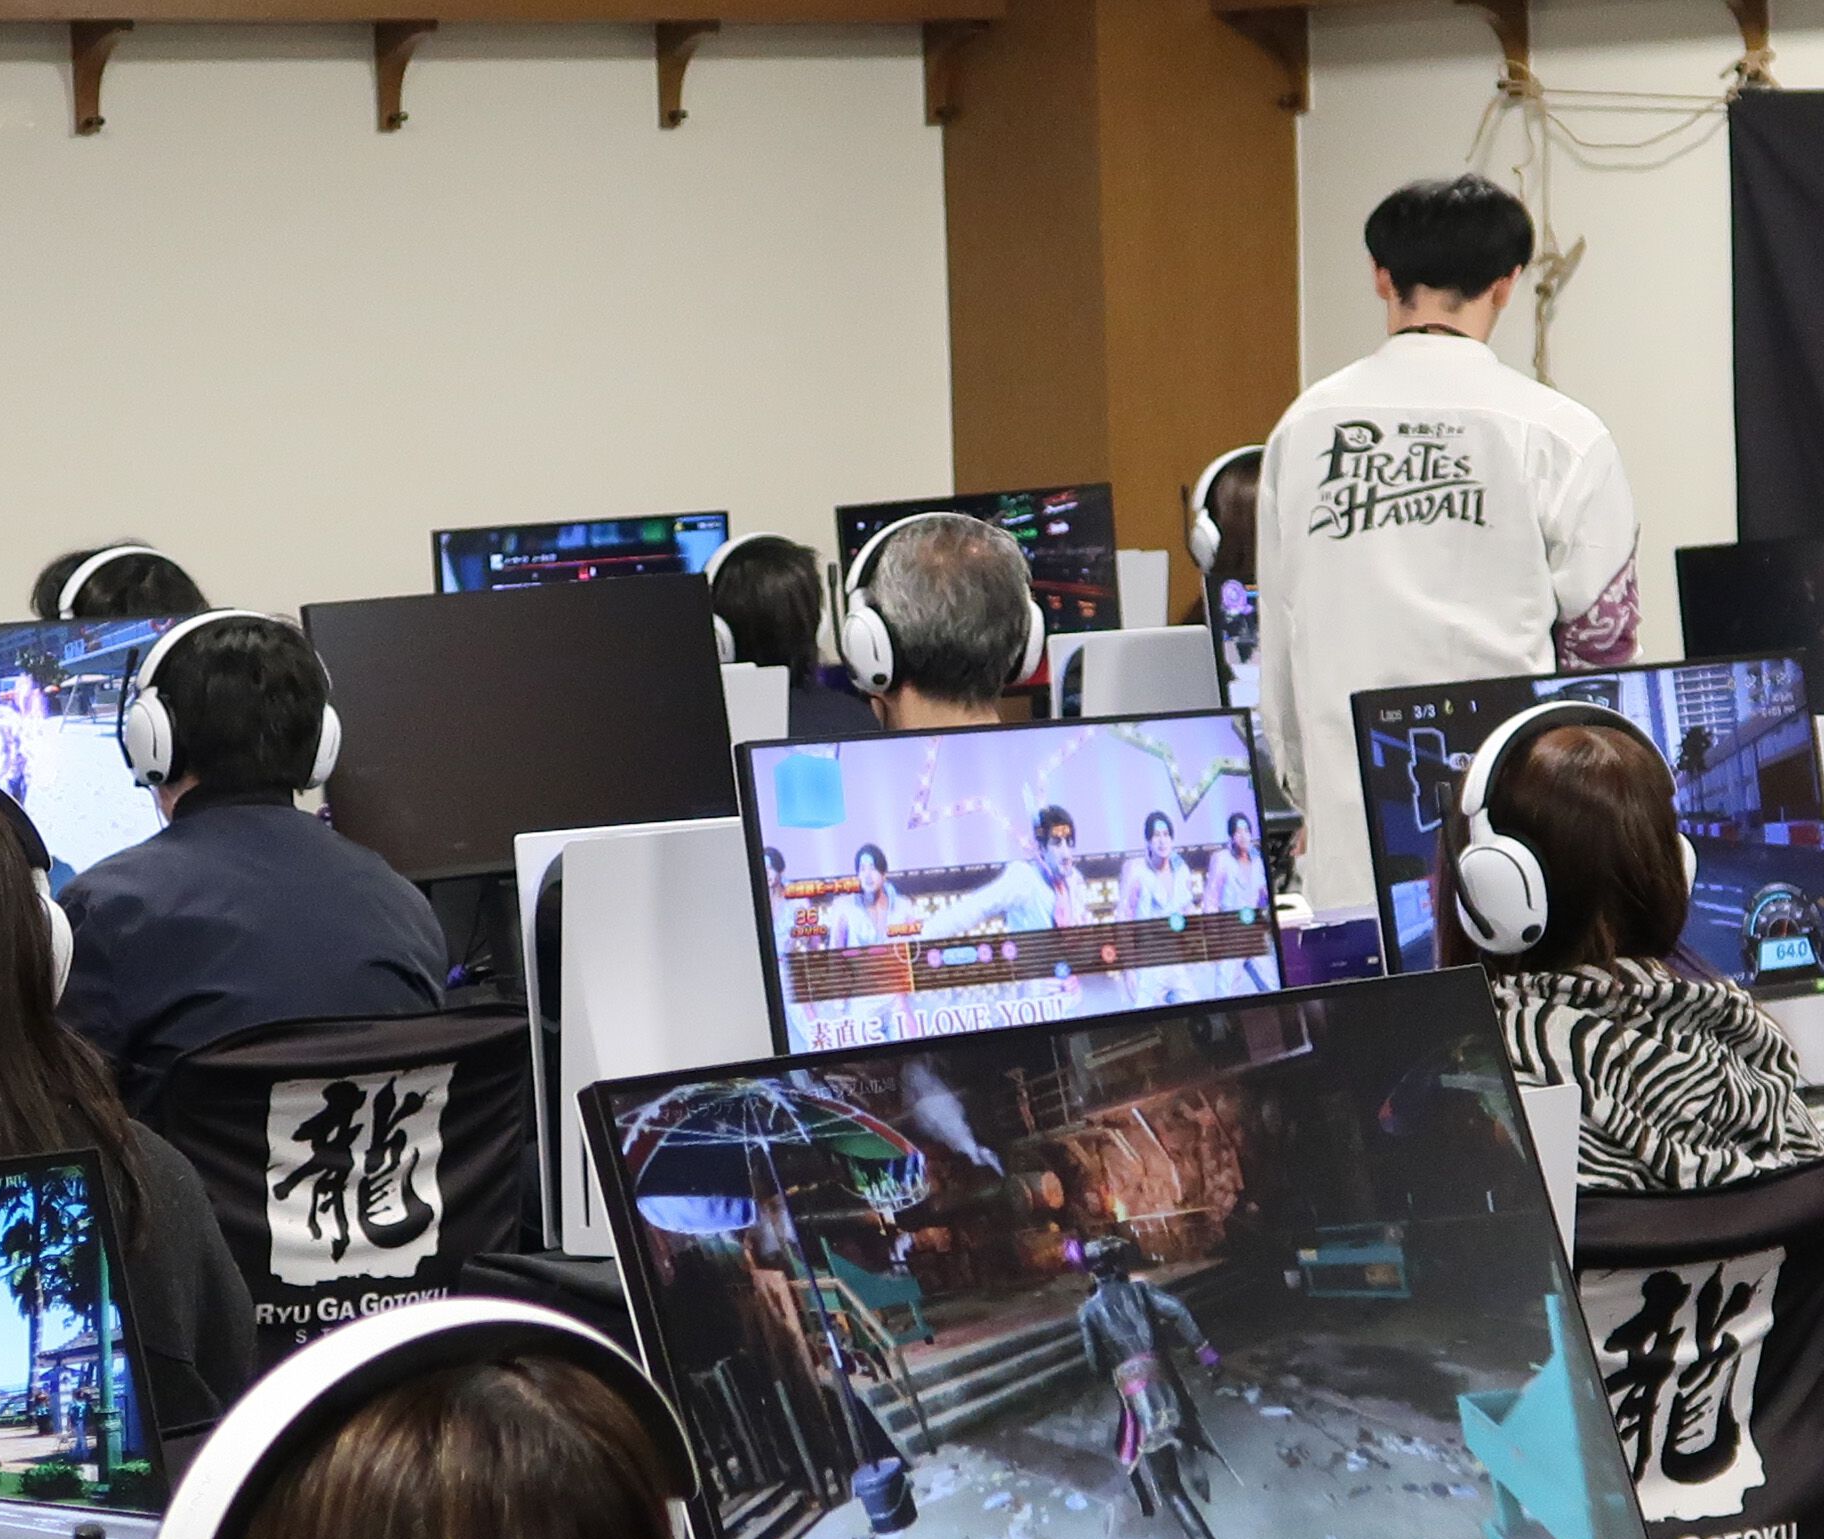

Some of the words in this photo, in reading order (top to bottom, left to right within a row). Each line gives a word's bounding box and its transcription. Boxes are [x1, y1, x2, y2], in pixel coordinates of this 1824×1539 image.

[1316, 420, 1473, 488] PIRATES
[1309, 479, 1487, 540] HAWAII
[810, 1019, 883, 1050] 素直に
[896, 1014, 905, 1039] I
[917, 1005, 987, 1037] LOVE
[274, 1077, 434, 1262] 龍
[255, 1303, 311, 1325] RYU
[317, 1297, 356, 1321] GA
